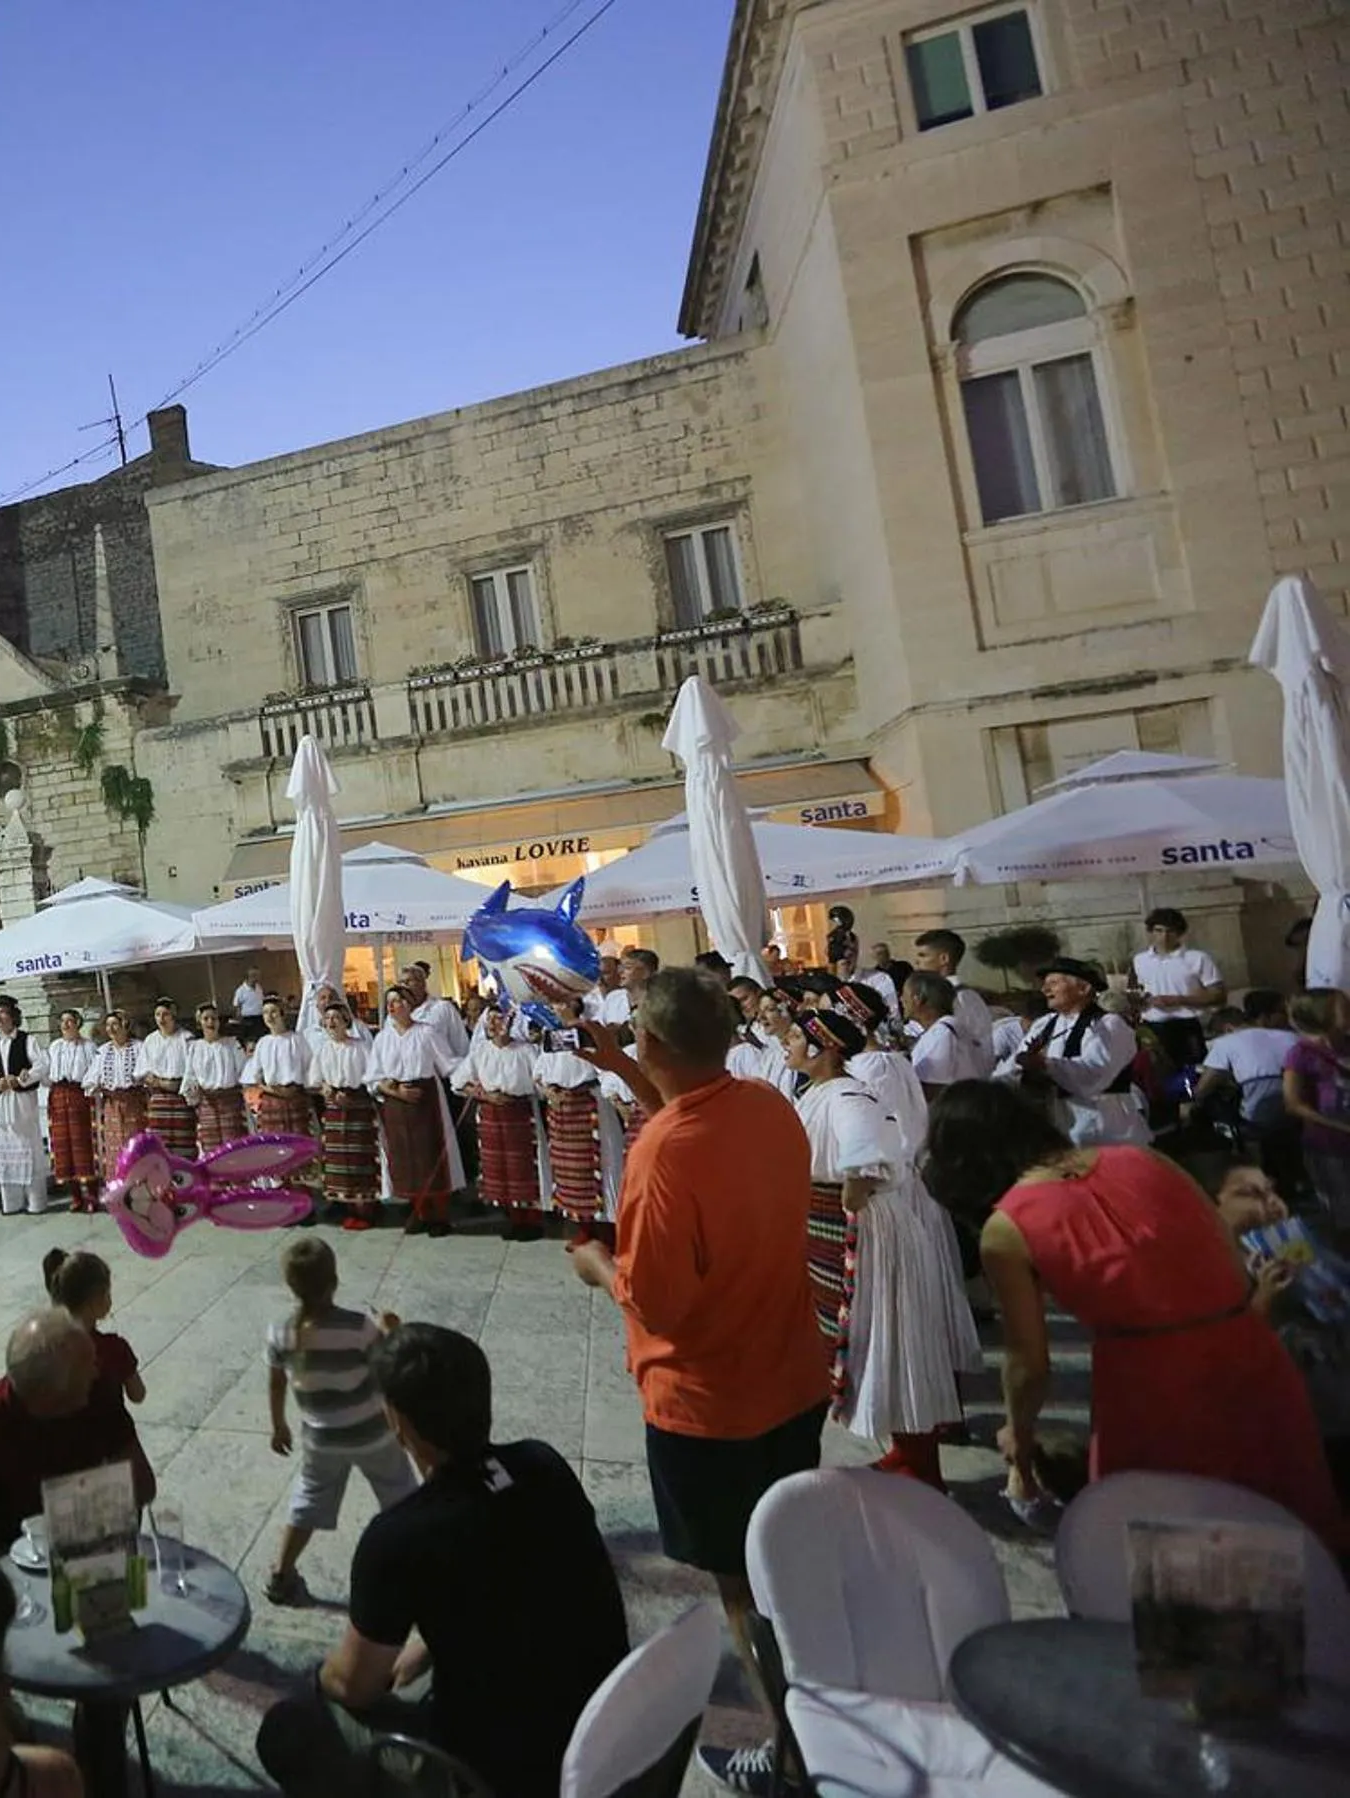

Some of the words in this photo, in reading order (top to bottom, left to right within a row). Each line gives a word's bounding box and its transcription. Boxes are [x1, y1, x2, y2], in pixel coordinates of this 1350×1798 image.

[801, 801, 867, 823] santa
[456, 855, 508, 869] kavana
[514, 836, 591, 862] LOVRE
[1161, 838, 1255, 865] santa
[233, 880, 281, 900] sant
[15, 953, 63, 973] santa
